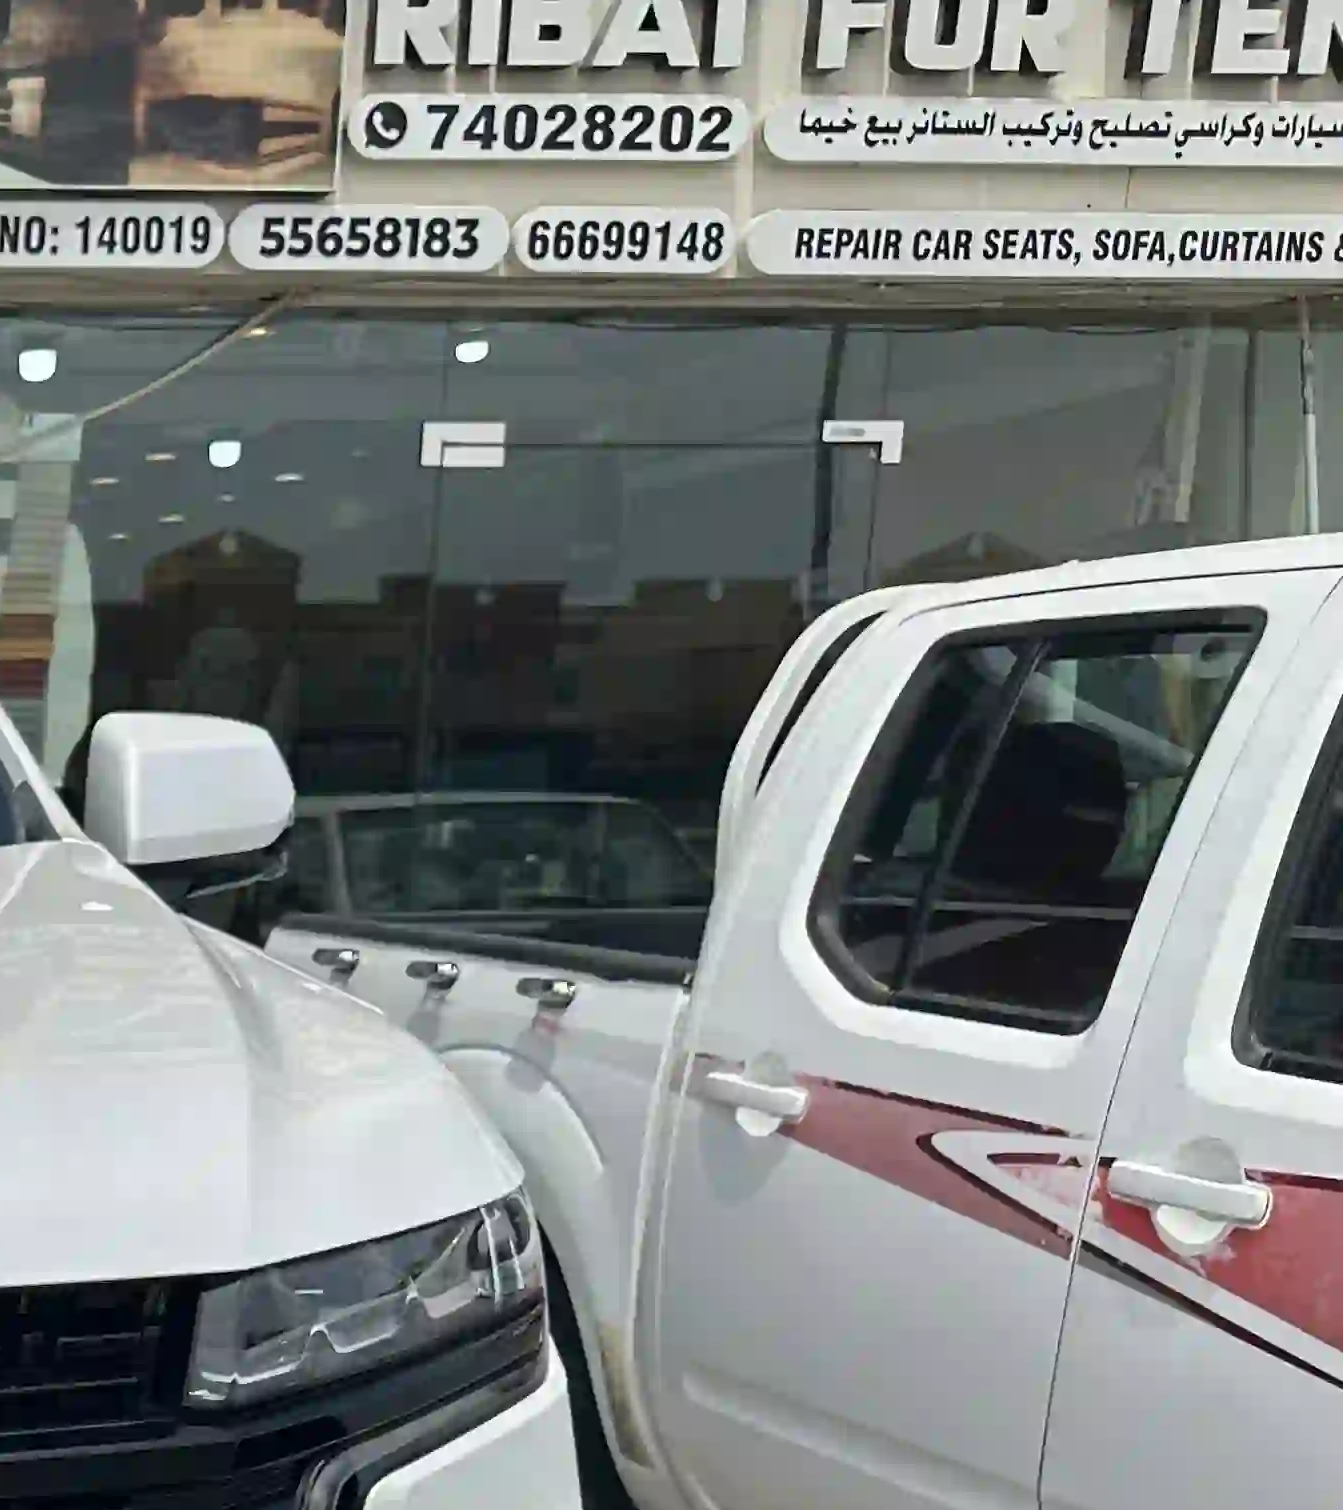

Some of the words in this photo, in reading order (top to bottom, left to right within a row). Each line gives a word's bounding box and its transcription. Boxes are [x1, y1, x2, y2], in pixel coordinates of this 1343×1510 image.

[816, 0, 1067, 71] FOR
[426, 103, 734, 152] 74028202
[863, 114, 903, 148] بيع
[1001, 108, 1083, 146] وتركيب
[1088, 110, 1173, 150] تصليح
[1174, 111, 1265, 159] وكراسي
[74, 215, 211, 256] 140019
[258, 217, 480, 259] 55658183
[527, 219, 726, 263] 66699148
[794, 227, 903, 260] REPAIR
[912, 228, 974, 261] CAR
[982, 228, 1082, 266] SEATS,
